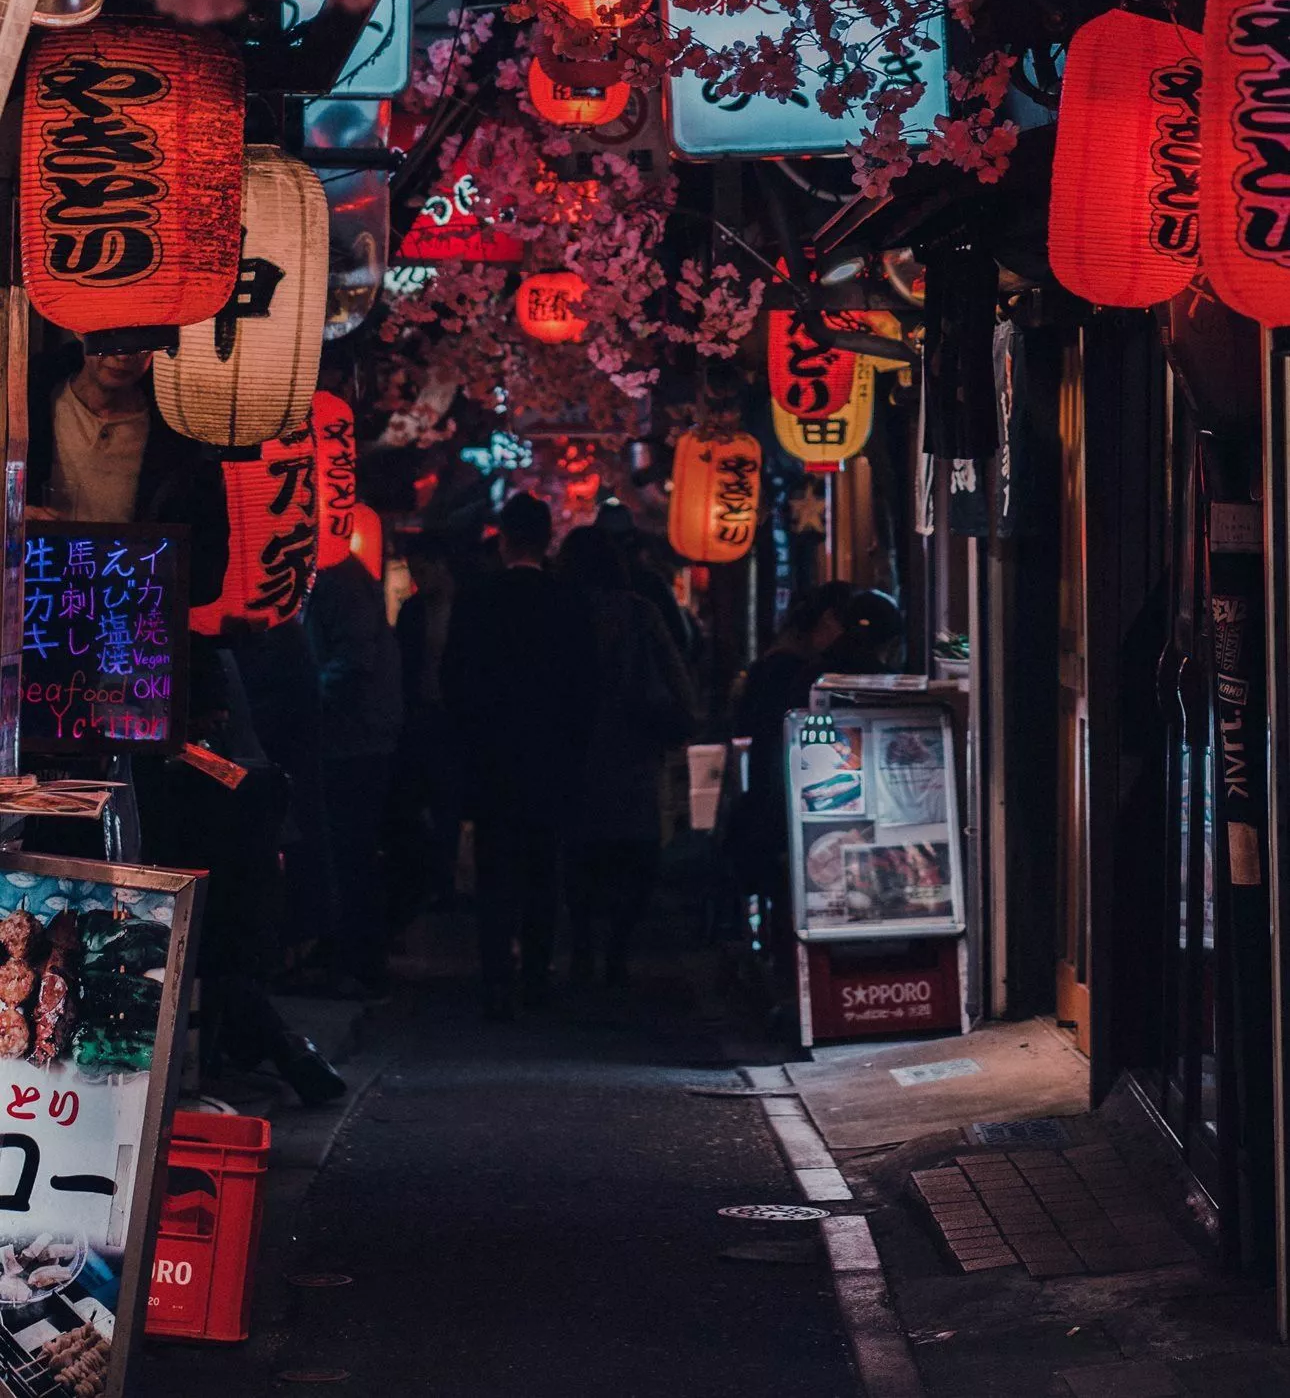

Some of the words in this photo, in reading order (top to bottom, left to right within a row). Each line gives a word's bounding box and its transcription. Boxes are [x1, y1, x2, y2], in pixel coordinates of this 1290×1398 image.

[37, 55, 170, 286] やきとり
[23, 537, 61, 659] 生カキ
[59, 540, 96, 655] 馬刺し
[95, 540, 136, 675] えび塩焼
[134, 538, 169, 646] イカ焼
[132, 648, 170, 670] Vegan
[6, 1084, 80, 1127] とり
[151, 1258, 193, 1286] RO
